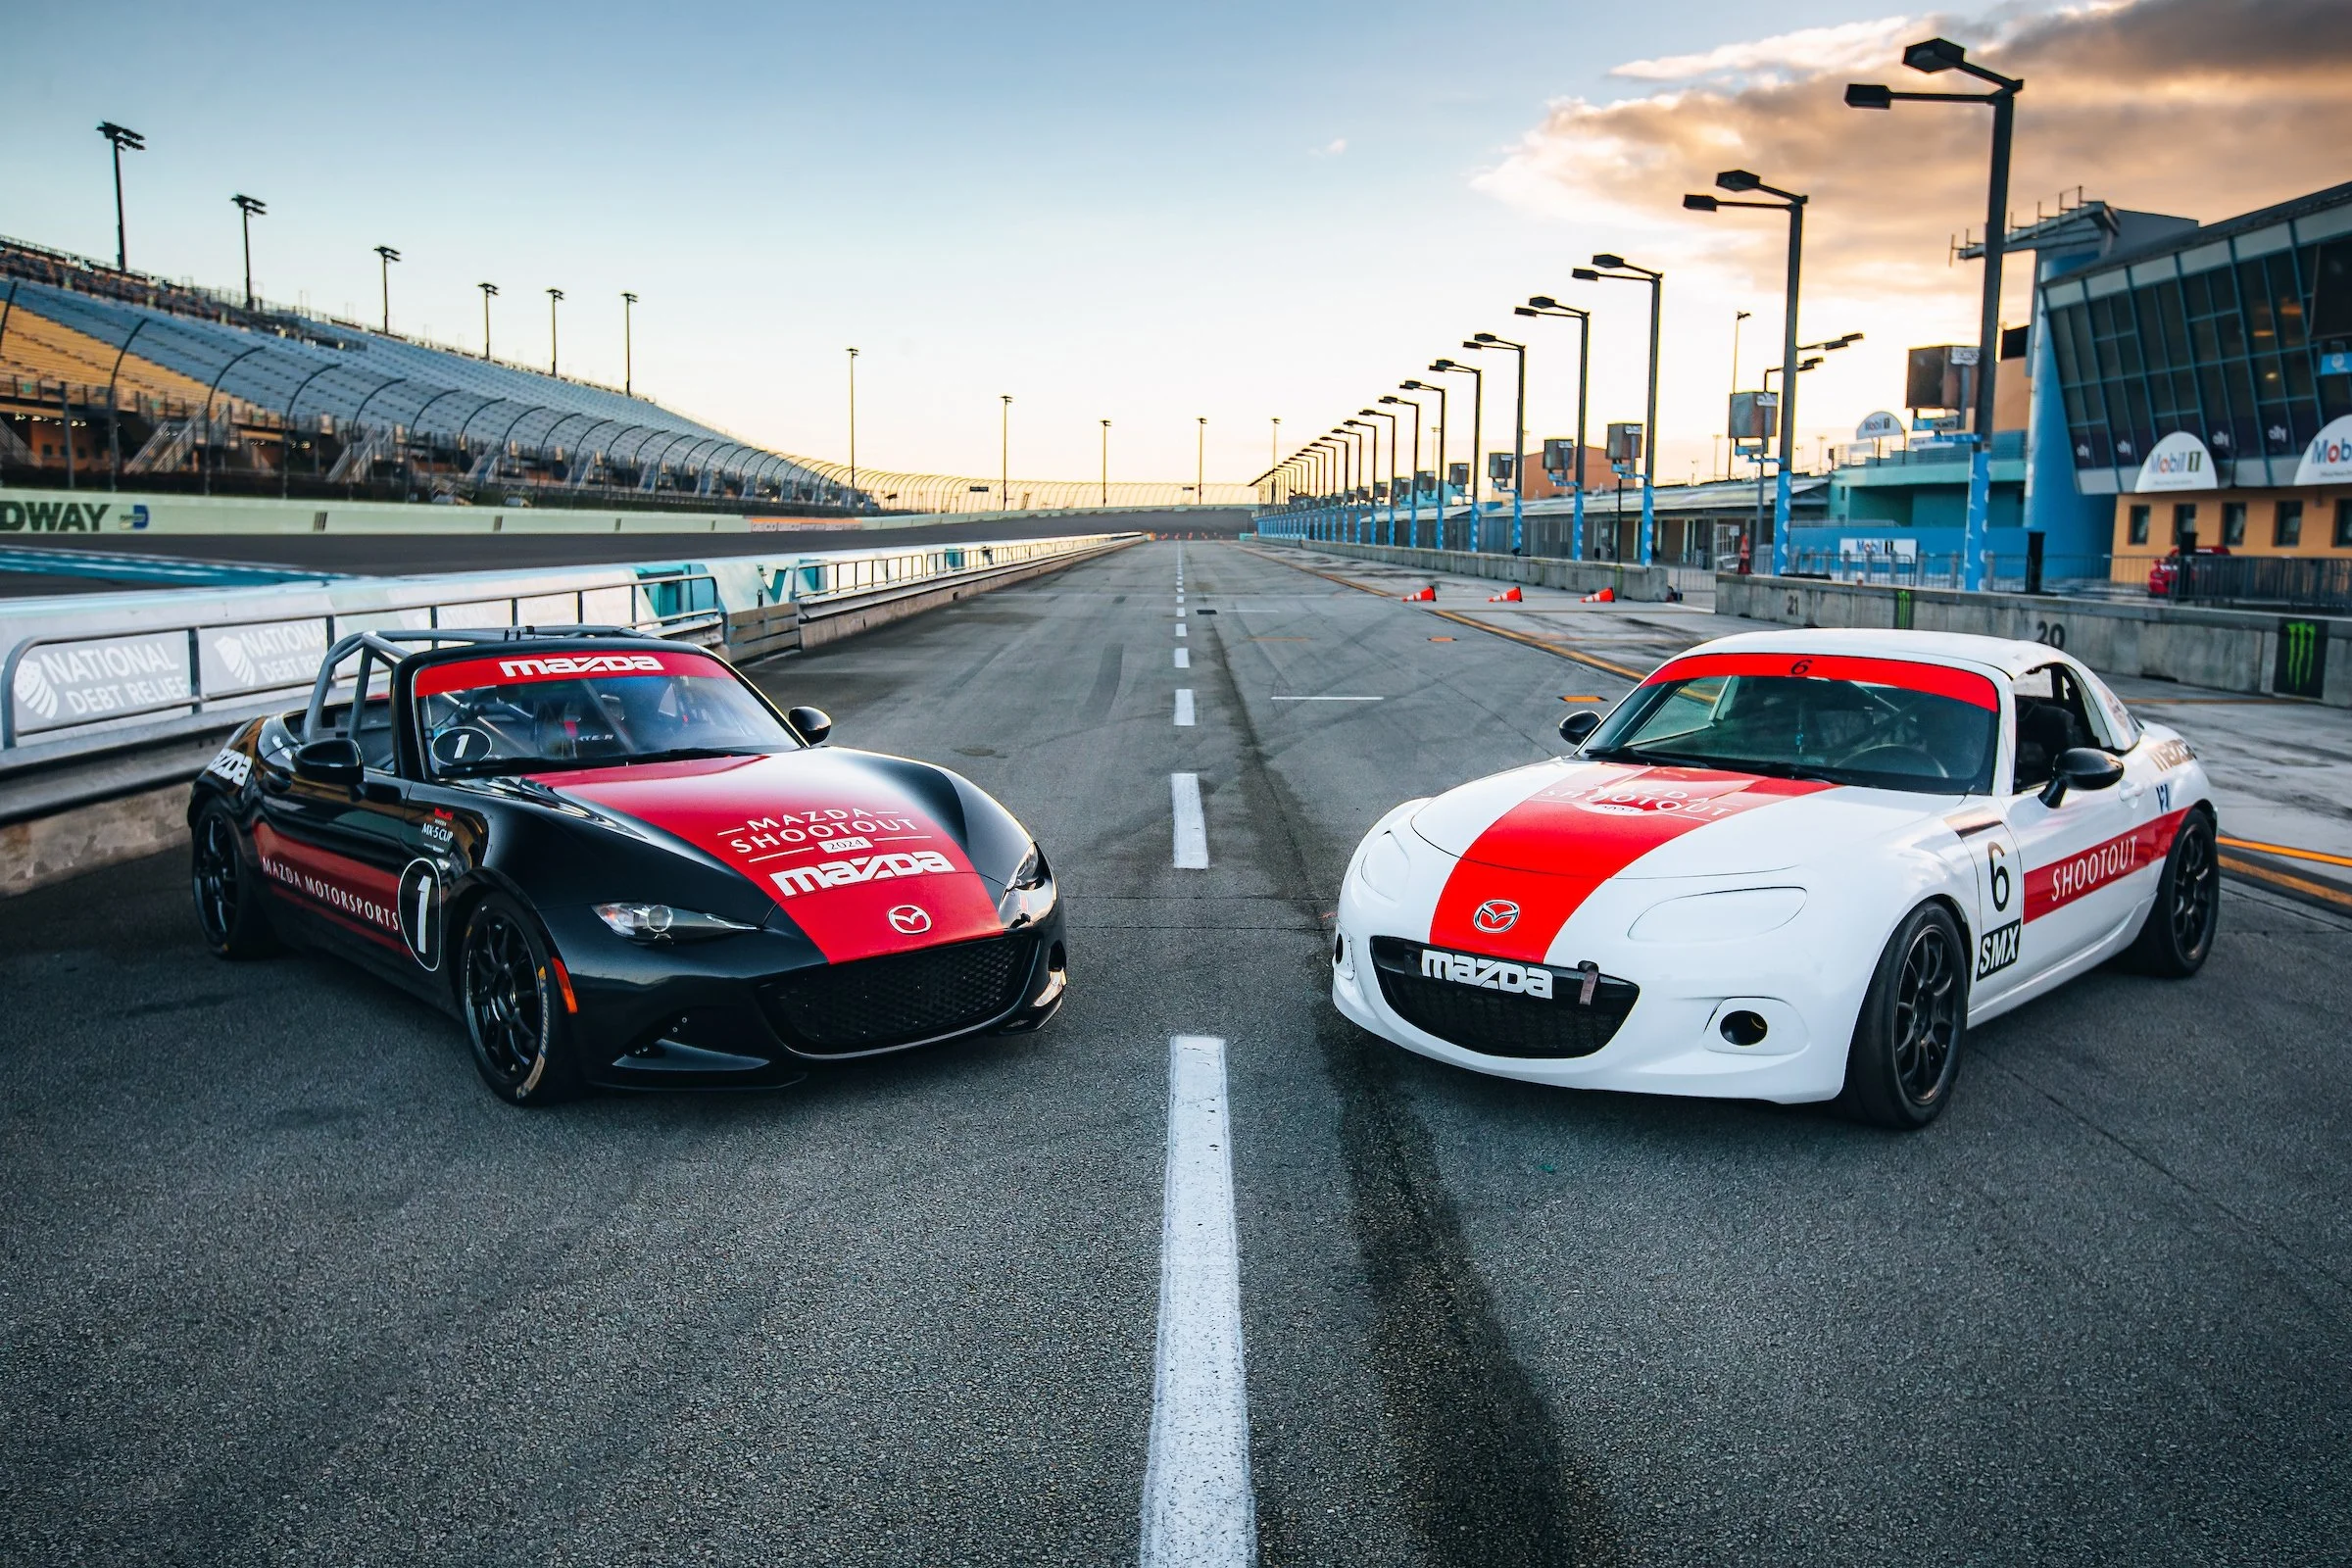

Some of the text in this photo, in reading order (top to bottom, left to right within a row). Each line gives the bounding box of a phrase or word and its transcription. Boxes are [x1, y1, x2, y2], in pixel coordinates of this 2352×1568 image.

[2149, 451, 2186, 474] Mobil
[0, 501, 111, 532] DWAY
[1787, 595, 1799, 616] 21
[2036, 620, 2066, 651] 20
[41, 642, 179, 684] NATIONAL
[259, 658, 301, 683] DEBT
[498, 655, 665, 678] mazda
[1790, 659, 1814, 675] 6
[65, 676, 191, 714] DEBT RELIEF
[454, 734, 470, 760] 1
[1541, 788, 1733, 816] SHOOTOUT
[438, 828, 454, 843] CUP
[746, 808, 872, 832] MAZDA
[730, 818, 918, 854] SHOOTOUT
[826, 839, 865, 851] 2024
[769, 851, 956, 897] mazda
[1987, 841, 2010, 912] 6
[2051, 836, 2138, 902] SHOOTOUT
[263, 856, 399, 931] MAZDA MOTORSPORTS
[416, 875, 433, 955] 1
[1979, 924, 2020, 974] SMX
[1421, 949, 1553, 1000] mazda
